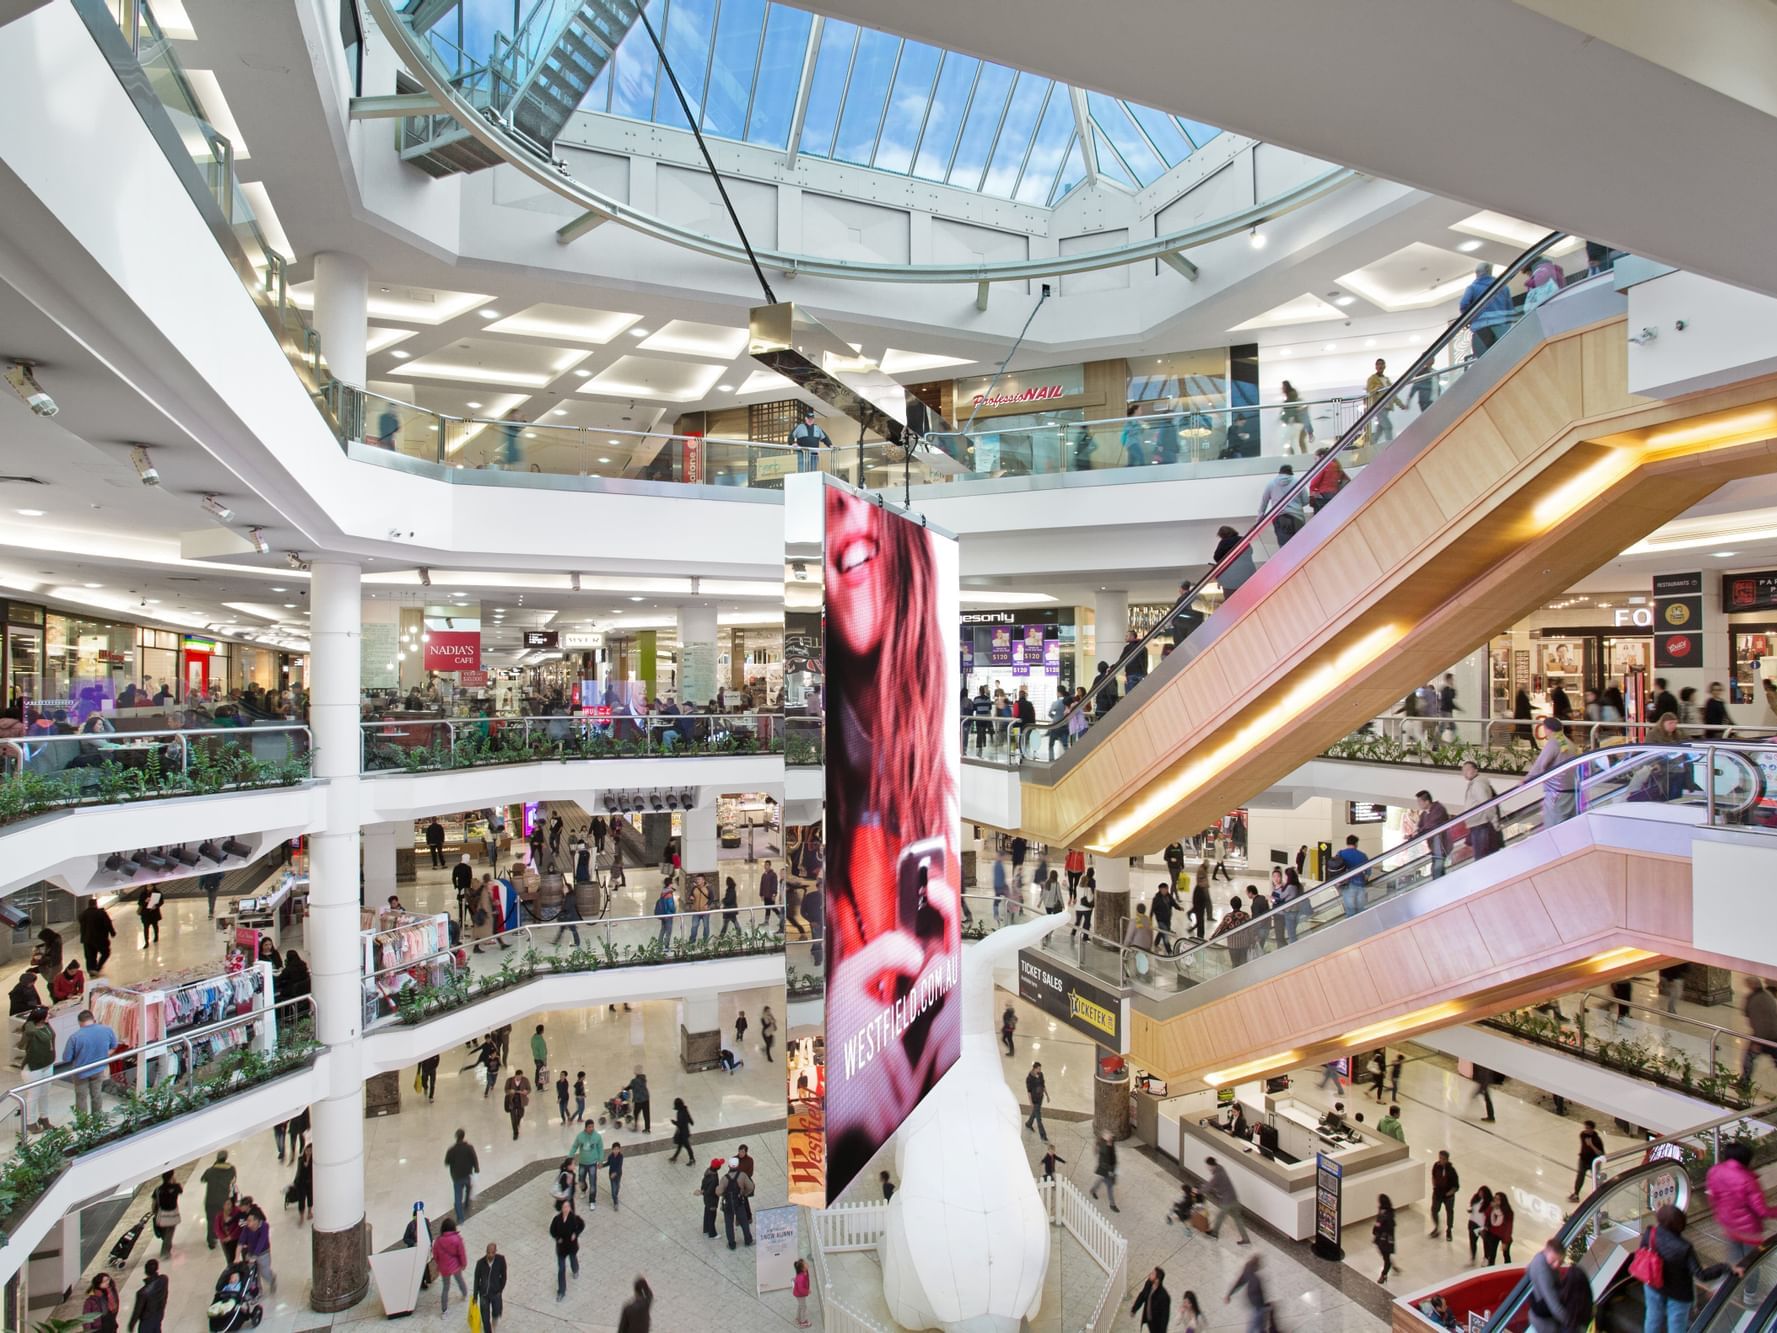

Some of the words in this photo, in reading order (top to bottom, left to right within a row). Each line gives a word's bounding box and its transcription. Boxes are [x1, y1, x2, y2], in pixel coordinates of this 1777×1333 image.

[687, 452, 697, 484] afone
[430, 645, 474, 655] NADIA'S
[1021, 960, 1041, 981] TICKET
[1042, 971, 1063, 993] SALES
[843, 954, 958, 1080] WESTFIELD.COM.AU
[791, 1088, 823, 1186] Westfield
